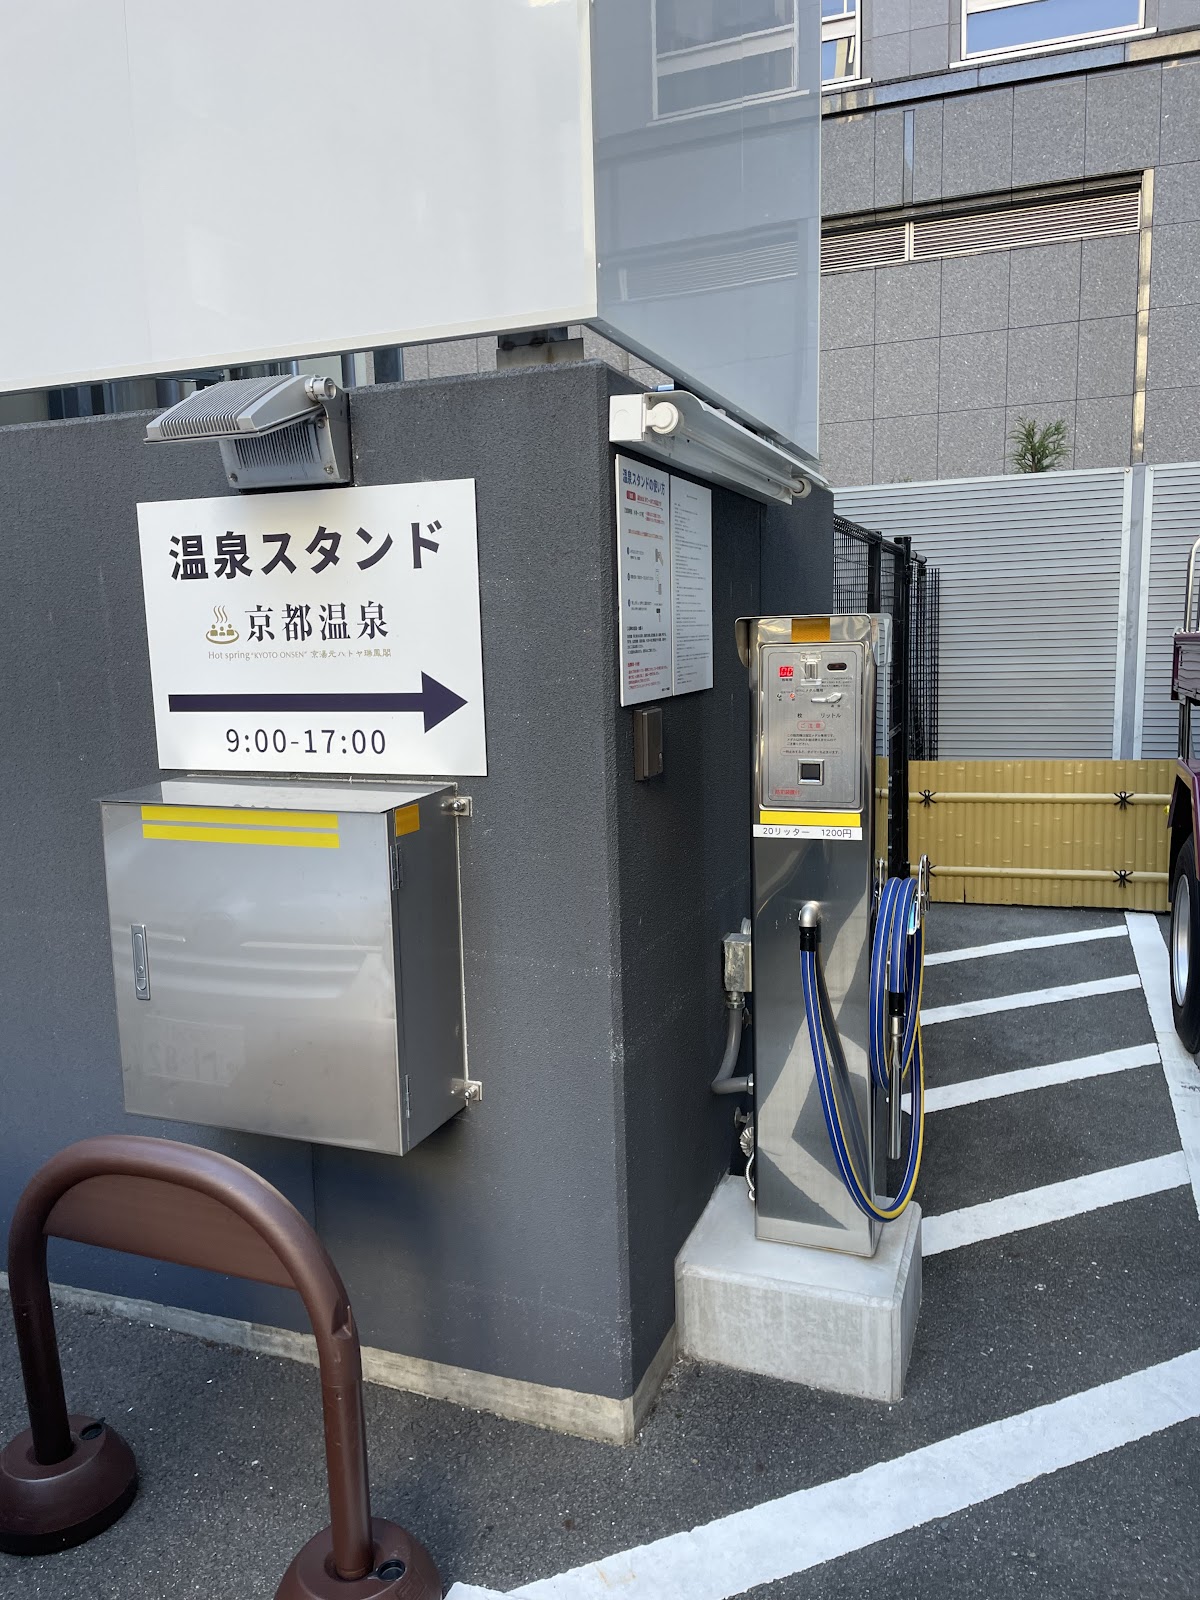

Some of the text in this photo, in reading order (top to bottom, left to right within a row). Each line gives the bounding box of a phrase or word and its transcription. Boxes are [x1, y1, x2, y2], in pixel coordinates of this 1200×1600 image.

[622, 468, 666, 496] 温泉スタンドの使い方
[168, 519, 443, 580] 温泉スタンド
[245, 600, 389, 642] 京都温泉
[208, 651, 222, 660] Hot
[224, 650, 251, 661] spring
[225, 728, 387, 755] 9:00-17:00
[763, 827, 852, 838] 20リッター 1200円
